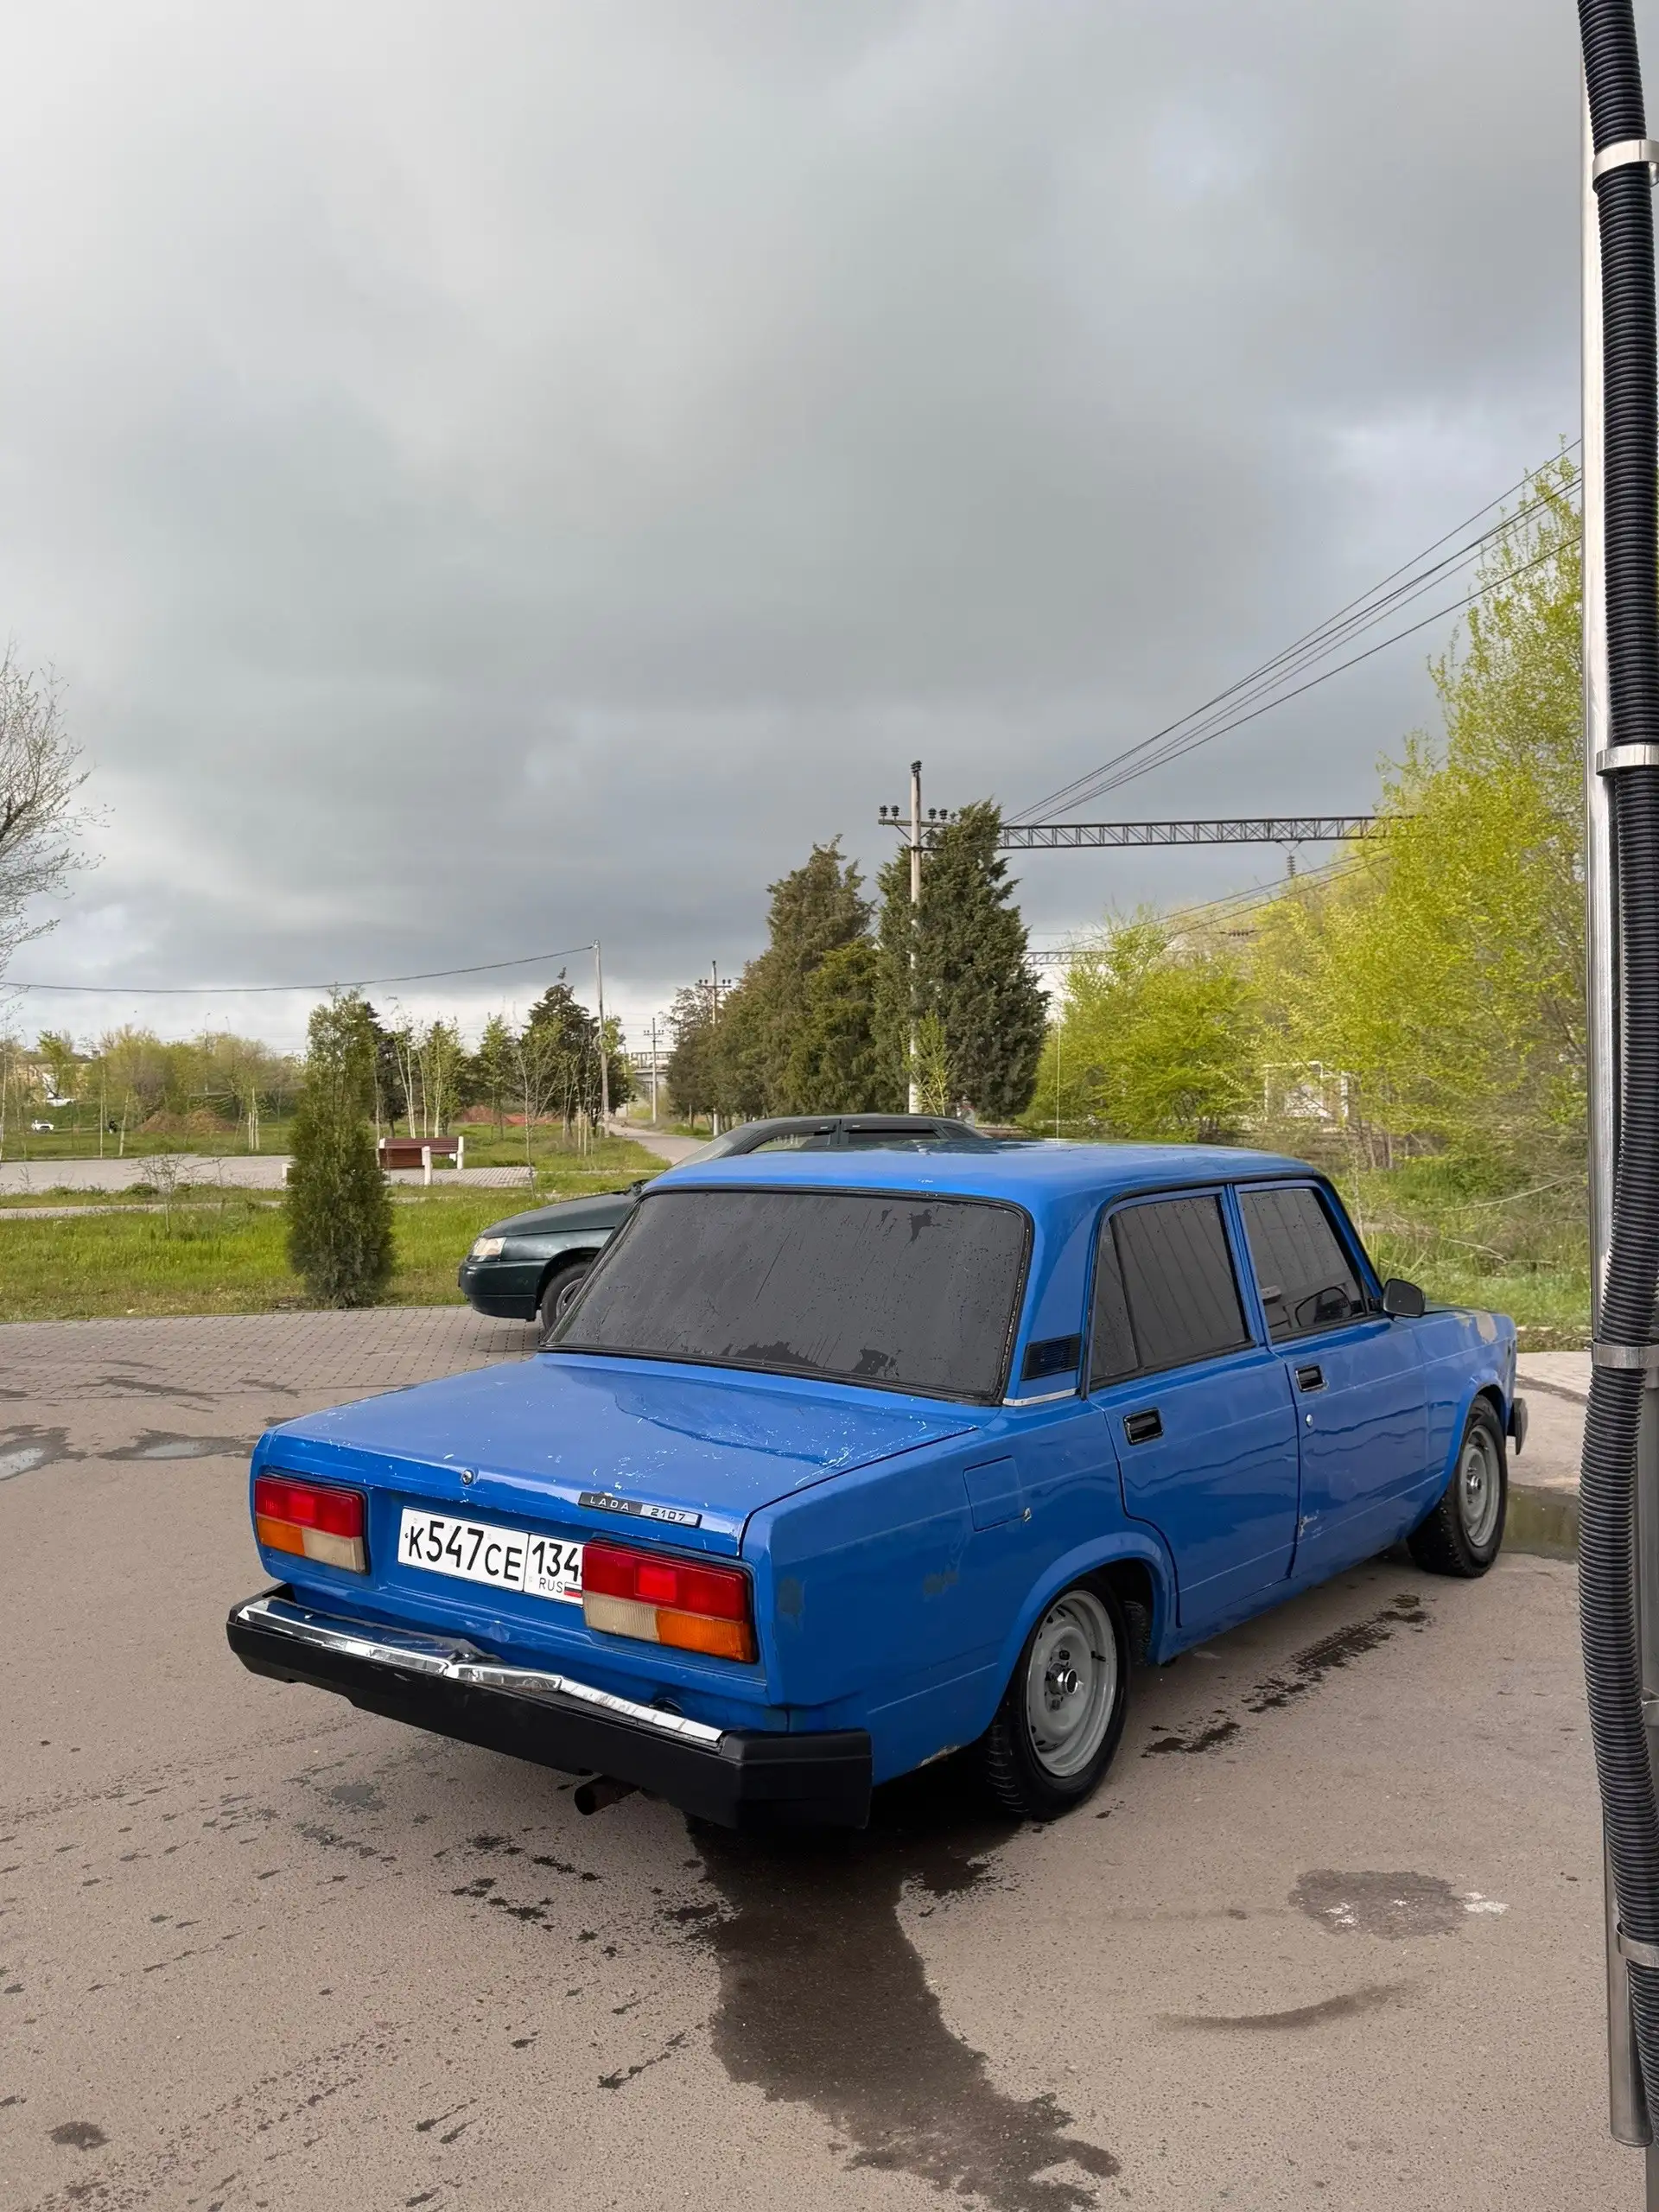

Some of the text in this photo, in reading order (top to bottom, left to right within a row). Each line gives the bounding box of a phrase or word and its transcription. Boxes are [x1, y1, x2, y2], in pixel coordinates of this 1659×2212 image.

[589, 1496, 686, 1522] LADA 2107
[531, 1541, 580, 1582] 134
[538, 1577, 563, 1593] RUS
